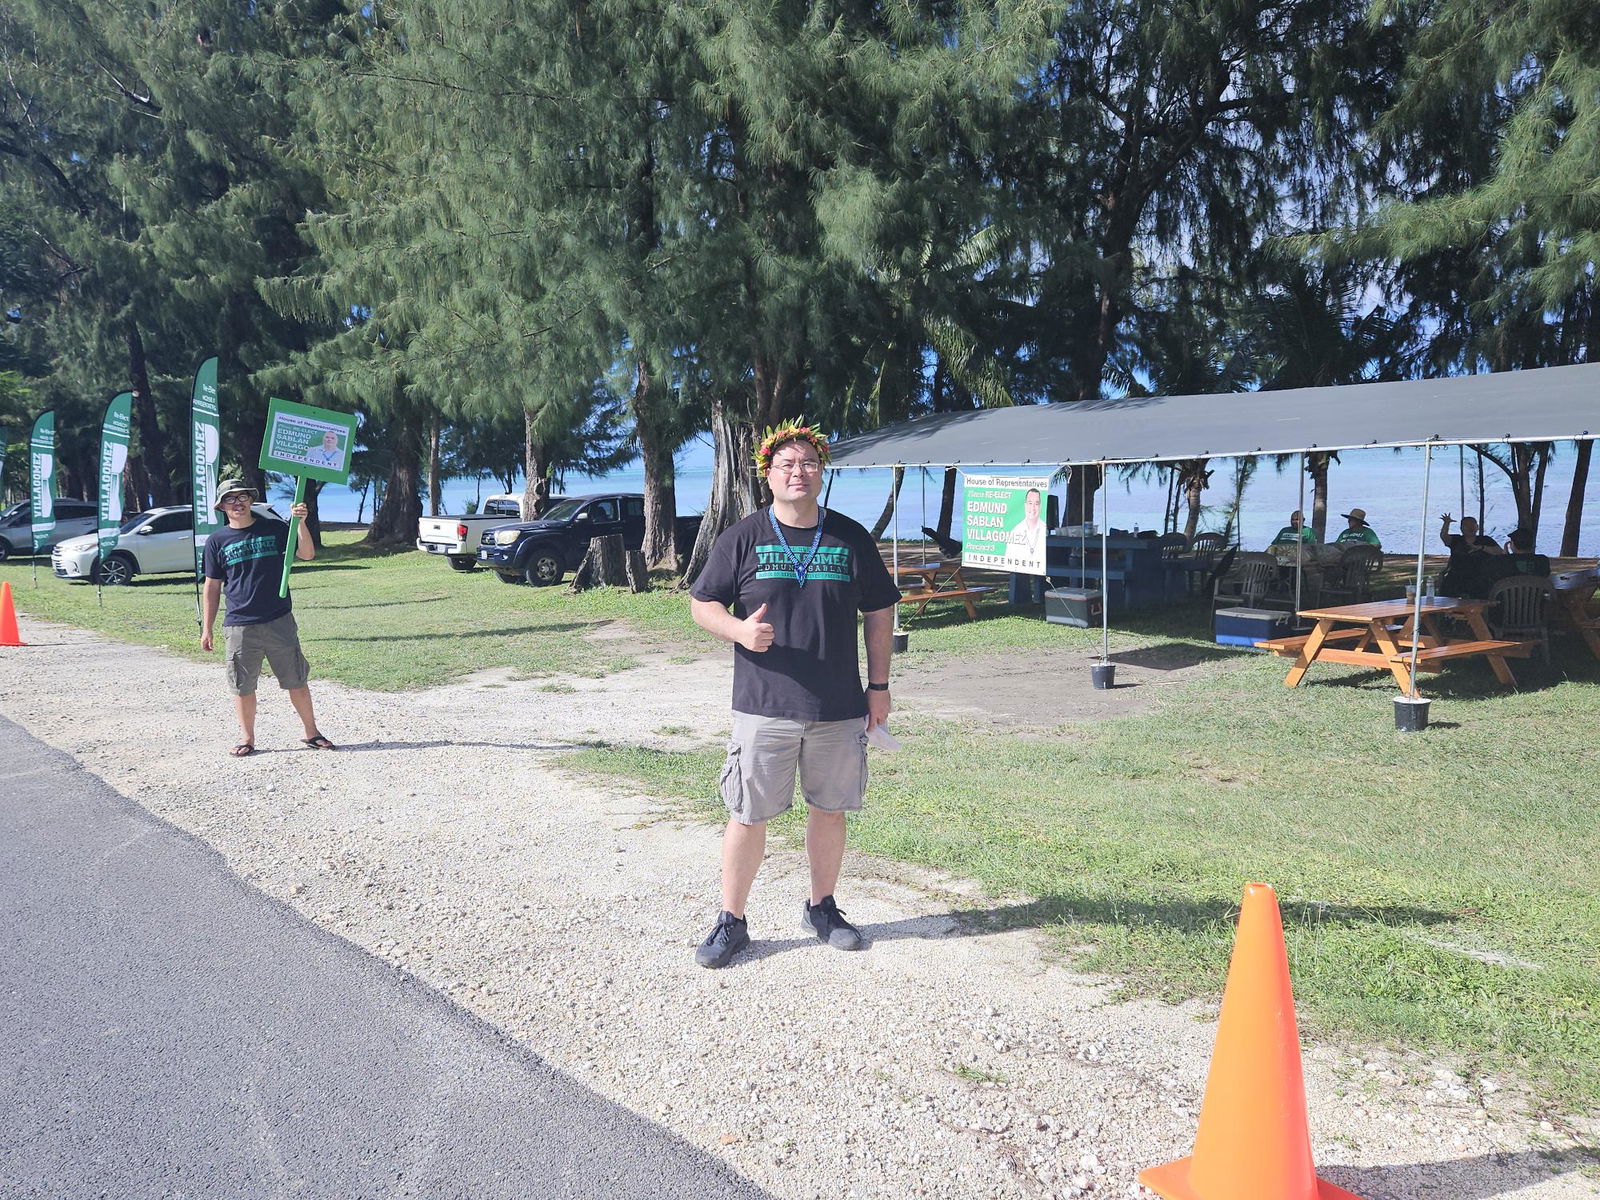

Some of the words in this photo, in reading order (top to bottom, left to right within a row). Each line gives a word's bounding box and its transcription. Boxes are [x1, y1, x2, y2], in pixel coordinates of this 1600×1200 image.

[279, 416, 297, 424] House
[304, 421, 346, 434] Representatives
[275, 433, 310, 445] SABLAN
[277, 428, 312, 440] EDMUND
[275, 451, 338, 467] INDEPENDENT
[195, 421, 209, 525] VILLAGOMEZ
[32, 452, 43, 518] VILLAGOMEZ
[101, 441, 113, 521] VILLAGOMEZ
[966, 478, 987, 486] House
[996, 479, 1048, 488] Representatives
[985, 491, 1013, 499] RE-ELECT
[967, 500, 1008, 514] EDMUND
[966, 515, 1005, 529] SABLAN
[966, 528, 1028, 545] VILLAGOMEZ
[968, 554, 1041, 568] INDEPENDENT
[757, 563, 797, 572] EDMUN
[808, 564, 849, 574] SABLAN
